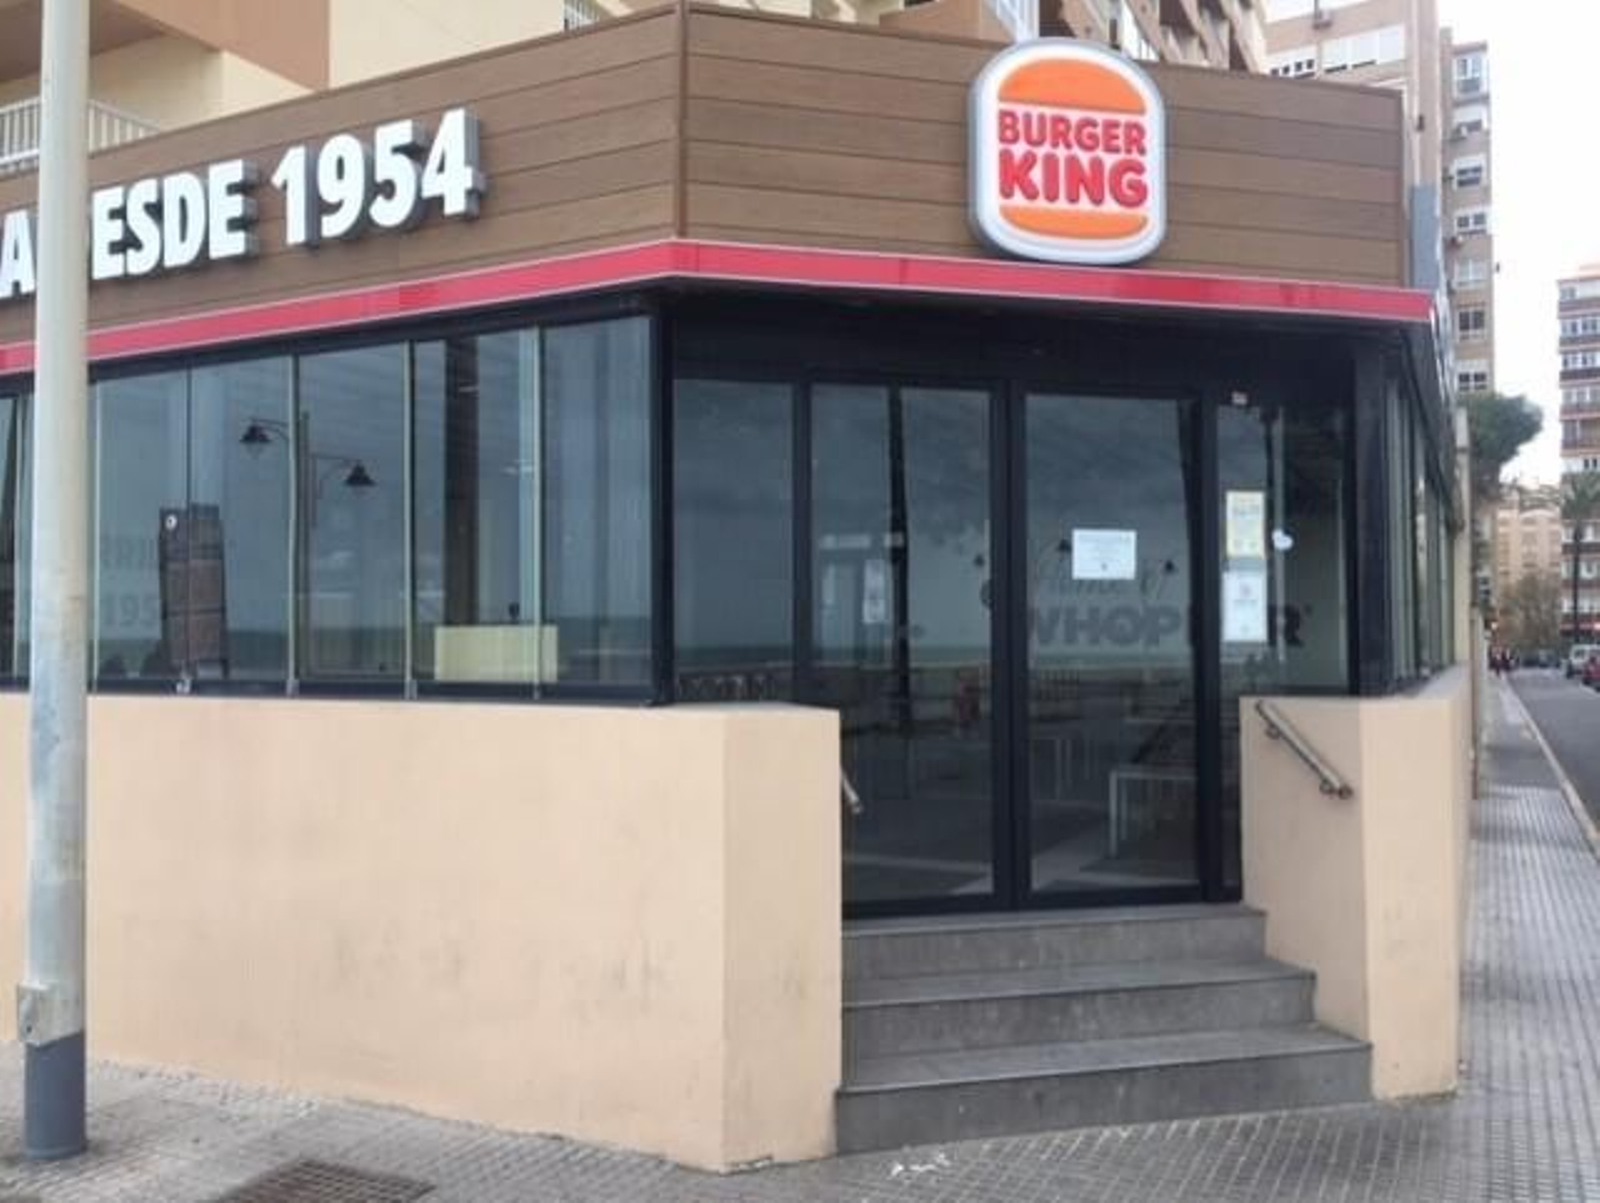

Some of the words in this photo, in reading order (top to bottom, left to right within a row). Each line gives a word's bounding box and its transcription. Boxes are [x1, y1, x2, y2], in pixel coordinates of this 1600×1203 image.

[998, 109, 1147, 155] BURGER
[91, 158, 248, 281] ESDE
[271, 107, 476, 246] 1954
[999, 148, 1149, 208] KING
